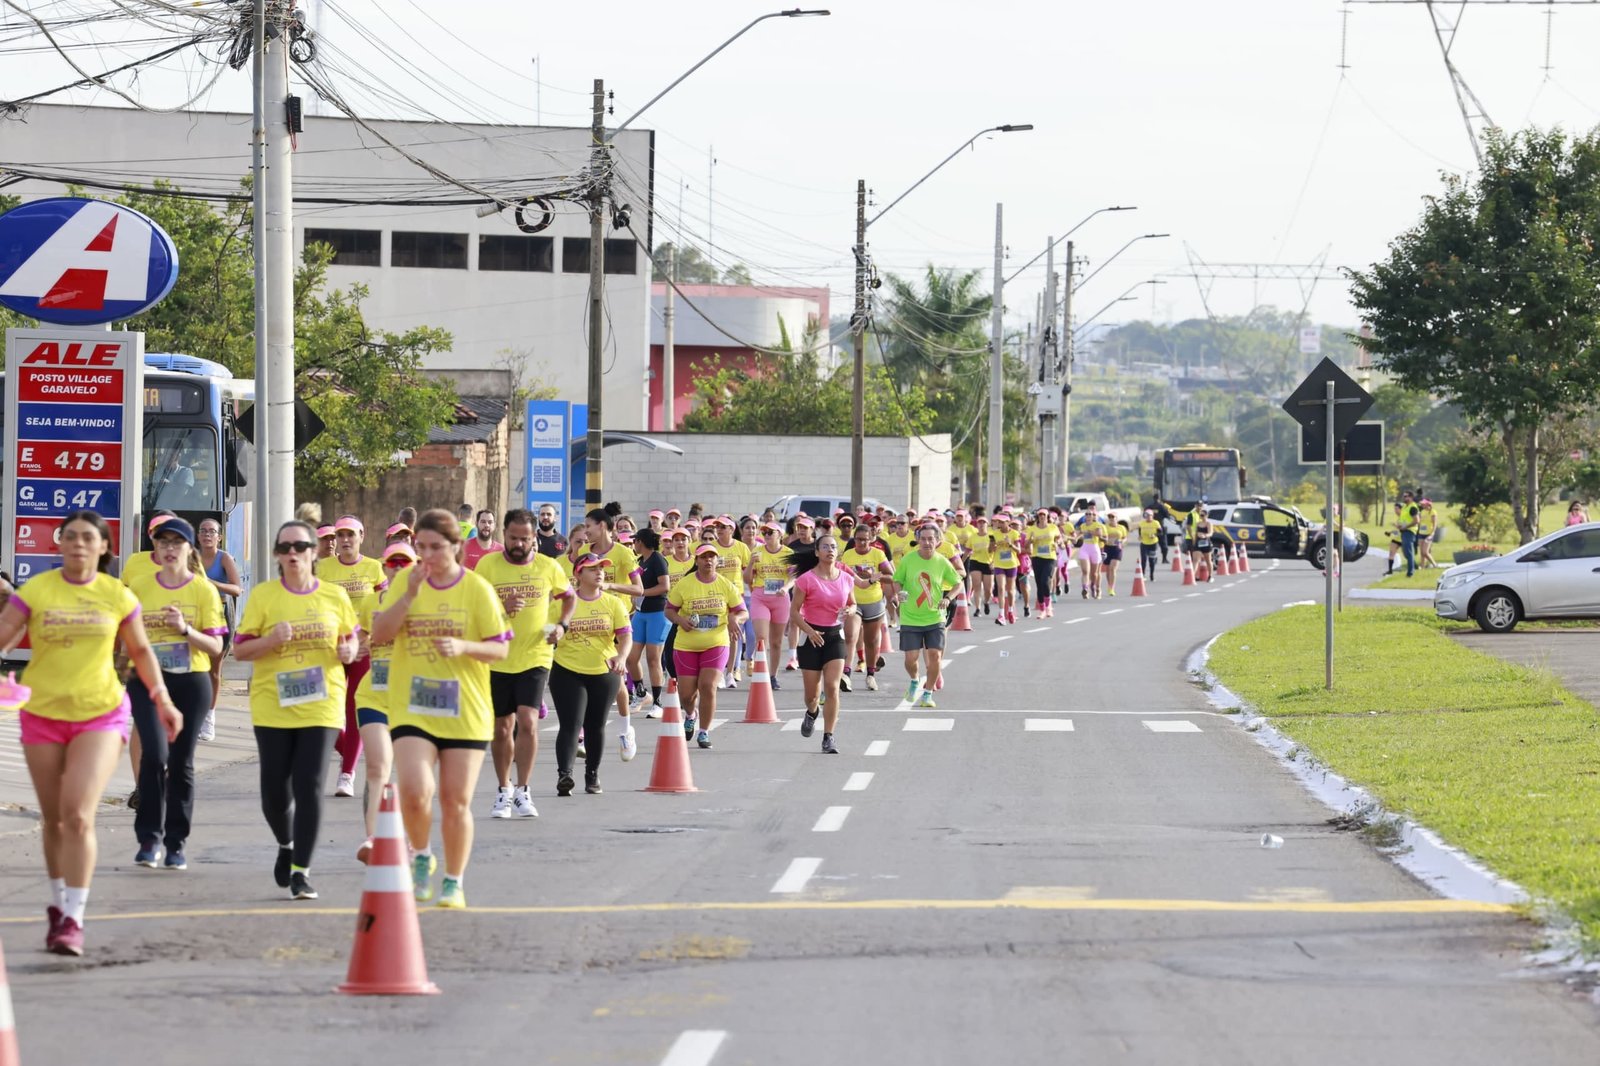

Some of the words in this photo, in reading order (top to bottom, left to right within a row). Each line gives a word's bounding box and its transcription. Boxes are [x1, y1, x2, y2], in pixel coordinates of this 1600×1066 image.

[22, 342, 122, 366] ALE
[30, 373, 66, 383] POSTO
[67, 374, 113, 384] VILLAGE
[40, 385, 98, 395] GARAVELO
[25, 416, 52, 426] SEJA
[54, 417, 116, 428] BEM-VINDO!
[21, 447, 34, 462] E
[19, 486, 35, 500] G
[18, 525, 32, 538] D
[17, 563, 31, 576] D
[569, 624, 610, 633] MULHERES
[570, 618, 604, 627] CIRCUITO
